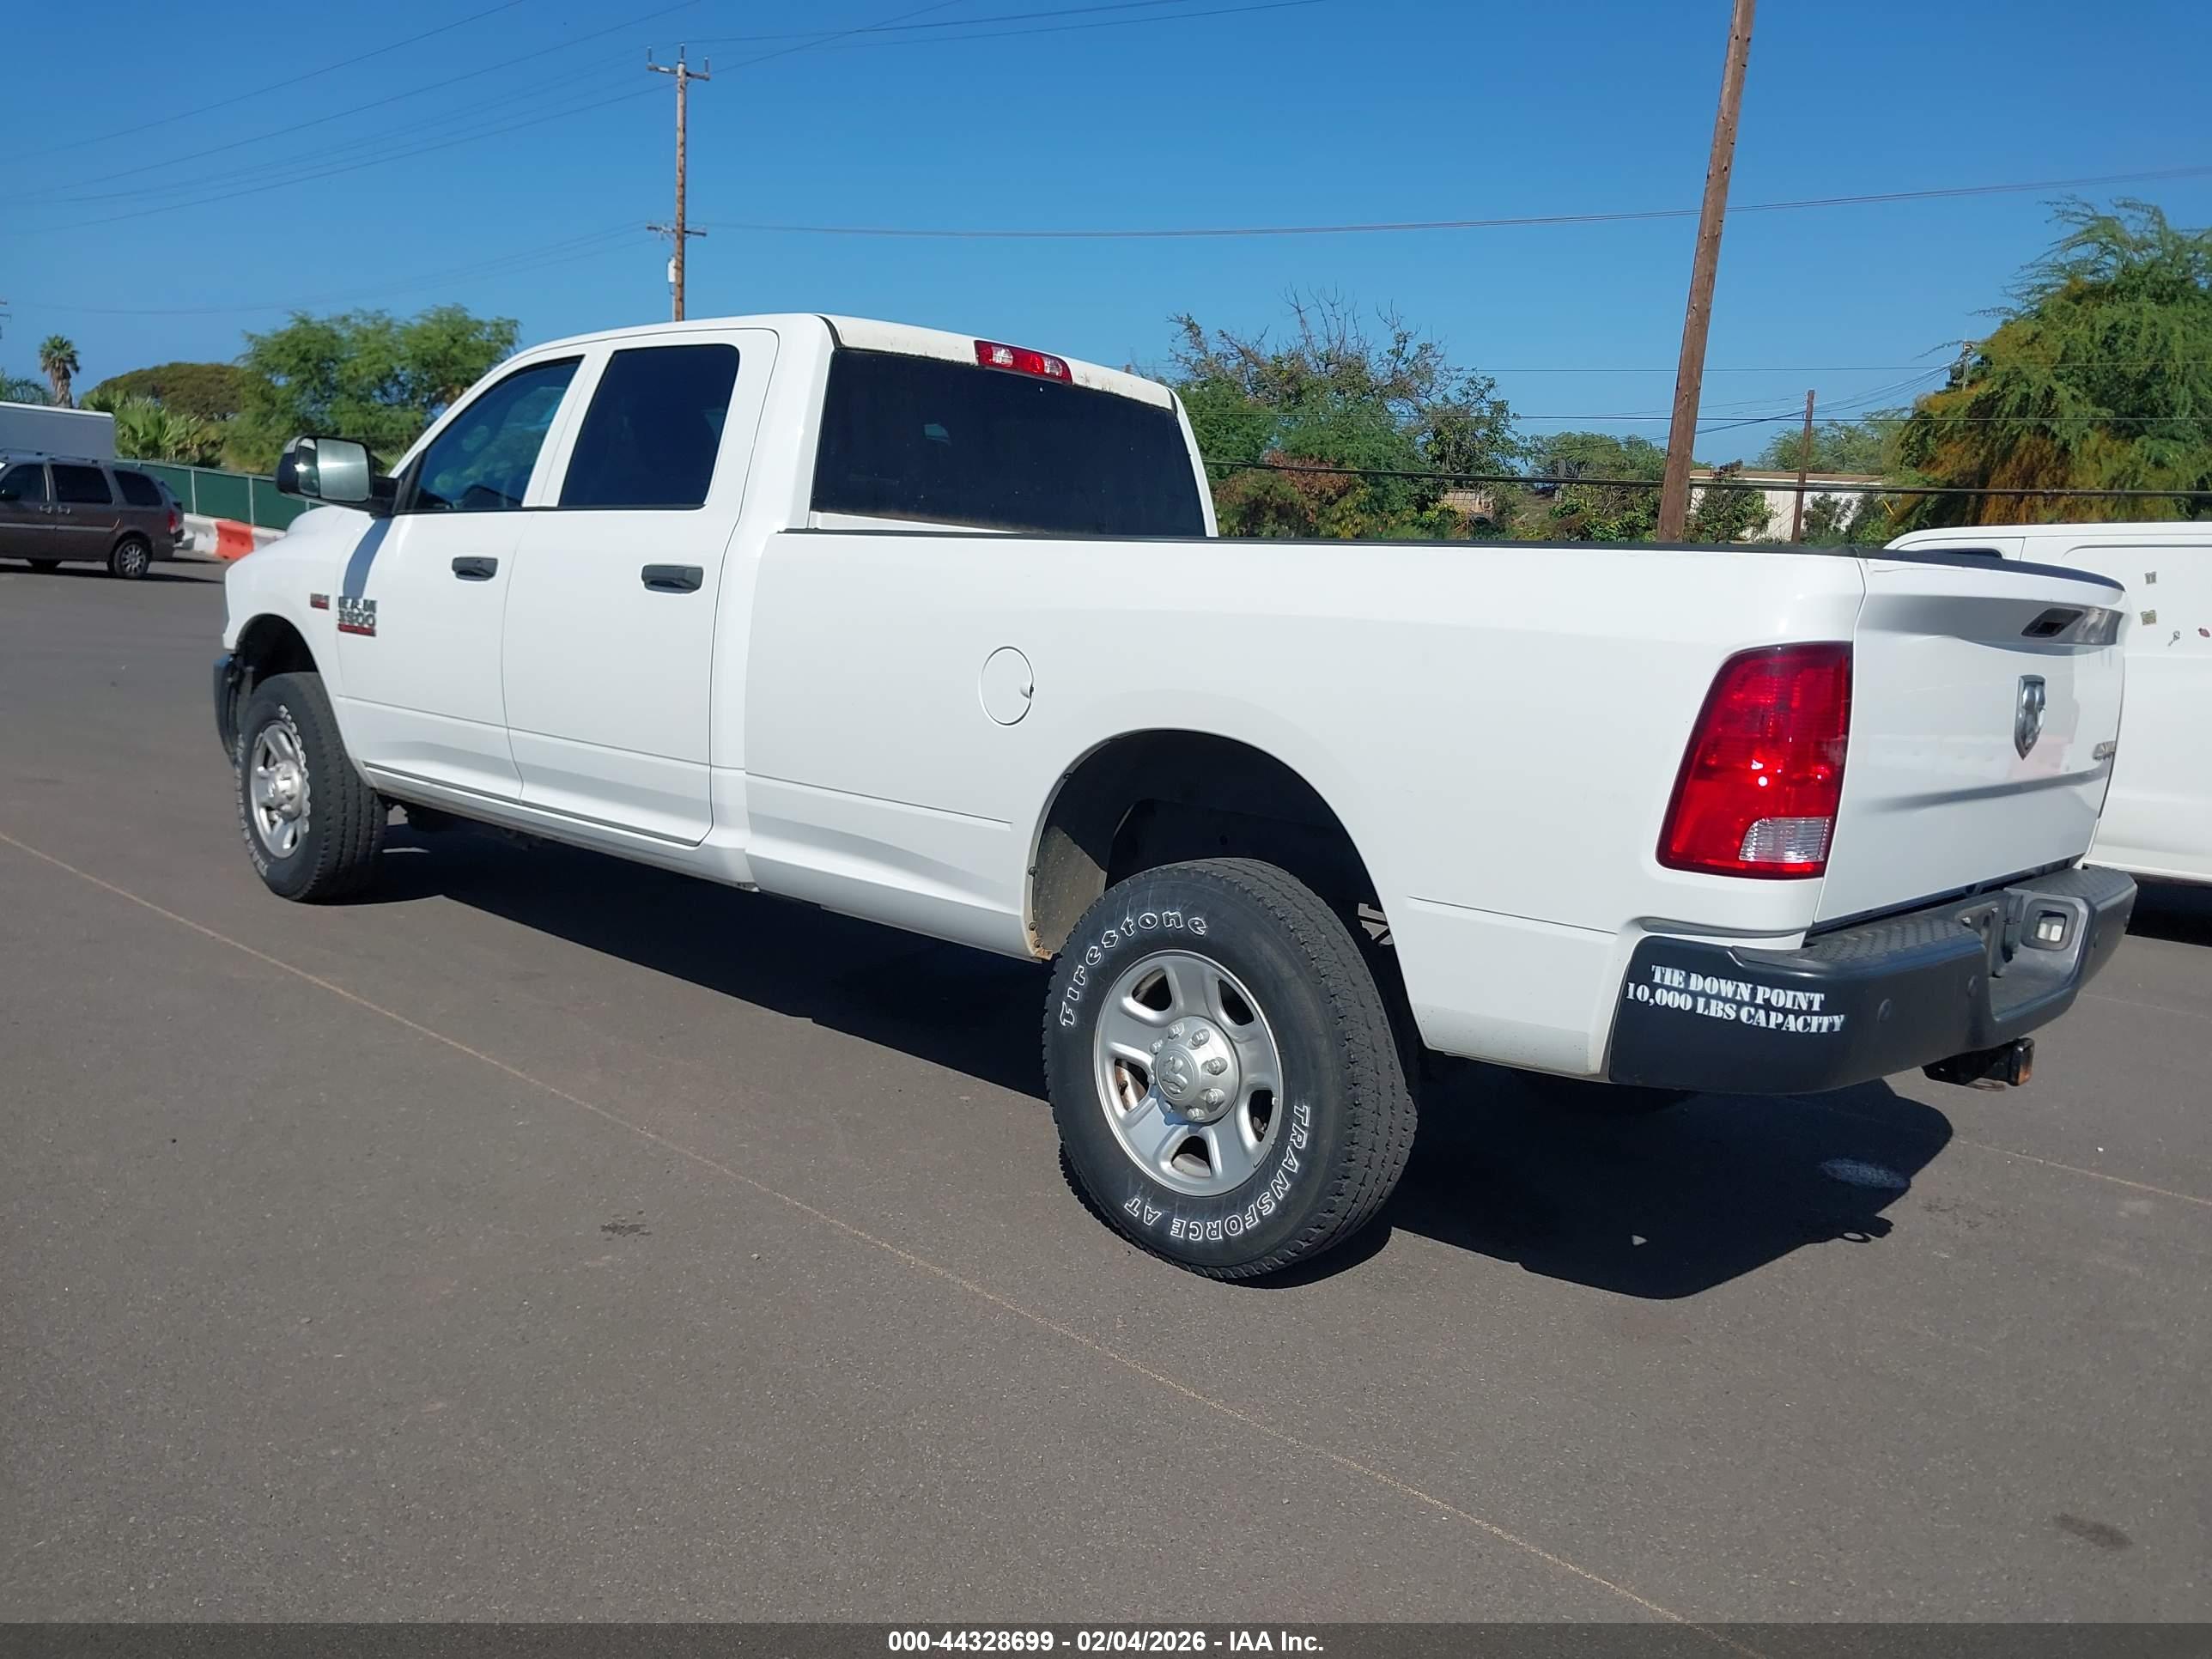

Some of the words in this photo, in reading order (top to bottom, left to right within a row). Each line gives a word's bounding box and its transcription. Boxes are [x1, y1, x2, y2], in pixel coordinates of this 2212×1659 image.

[1060, 910, 1207, 1027] Firestone
[1650, 964, 1686, 989] TIE
[1688, 972, 1753, 1002] DOWN
[1754, 985, 1826, 1012] POINT
[1626, 981, 1693, 1012] 10,000
[1695, 996, 1737, 1021] LBS
[1739, 1006, 1845, 1034] CAPACITY
[1170, 1104, 1310, 1241] TRANSFORCE
[1123, 1197, 1163, 1226] AT
